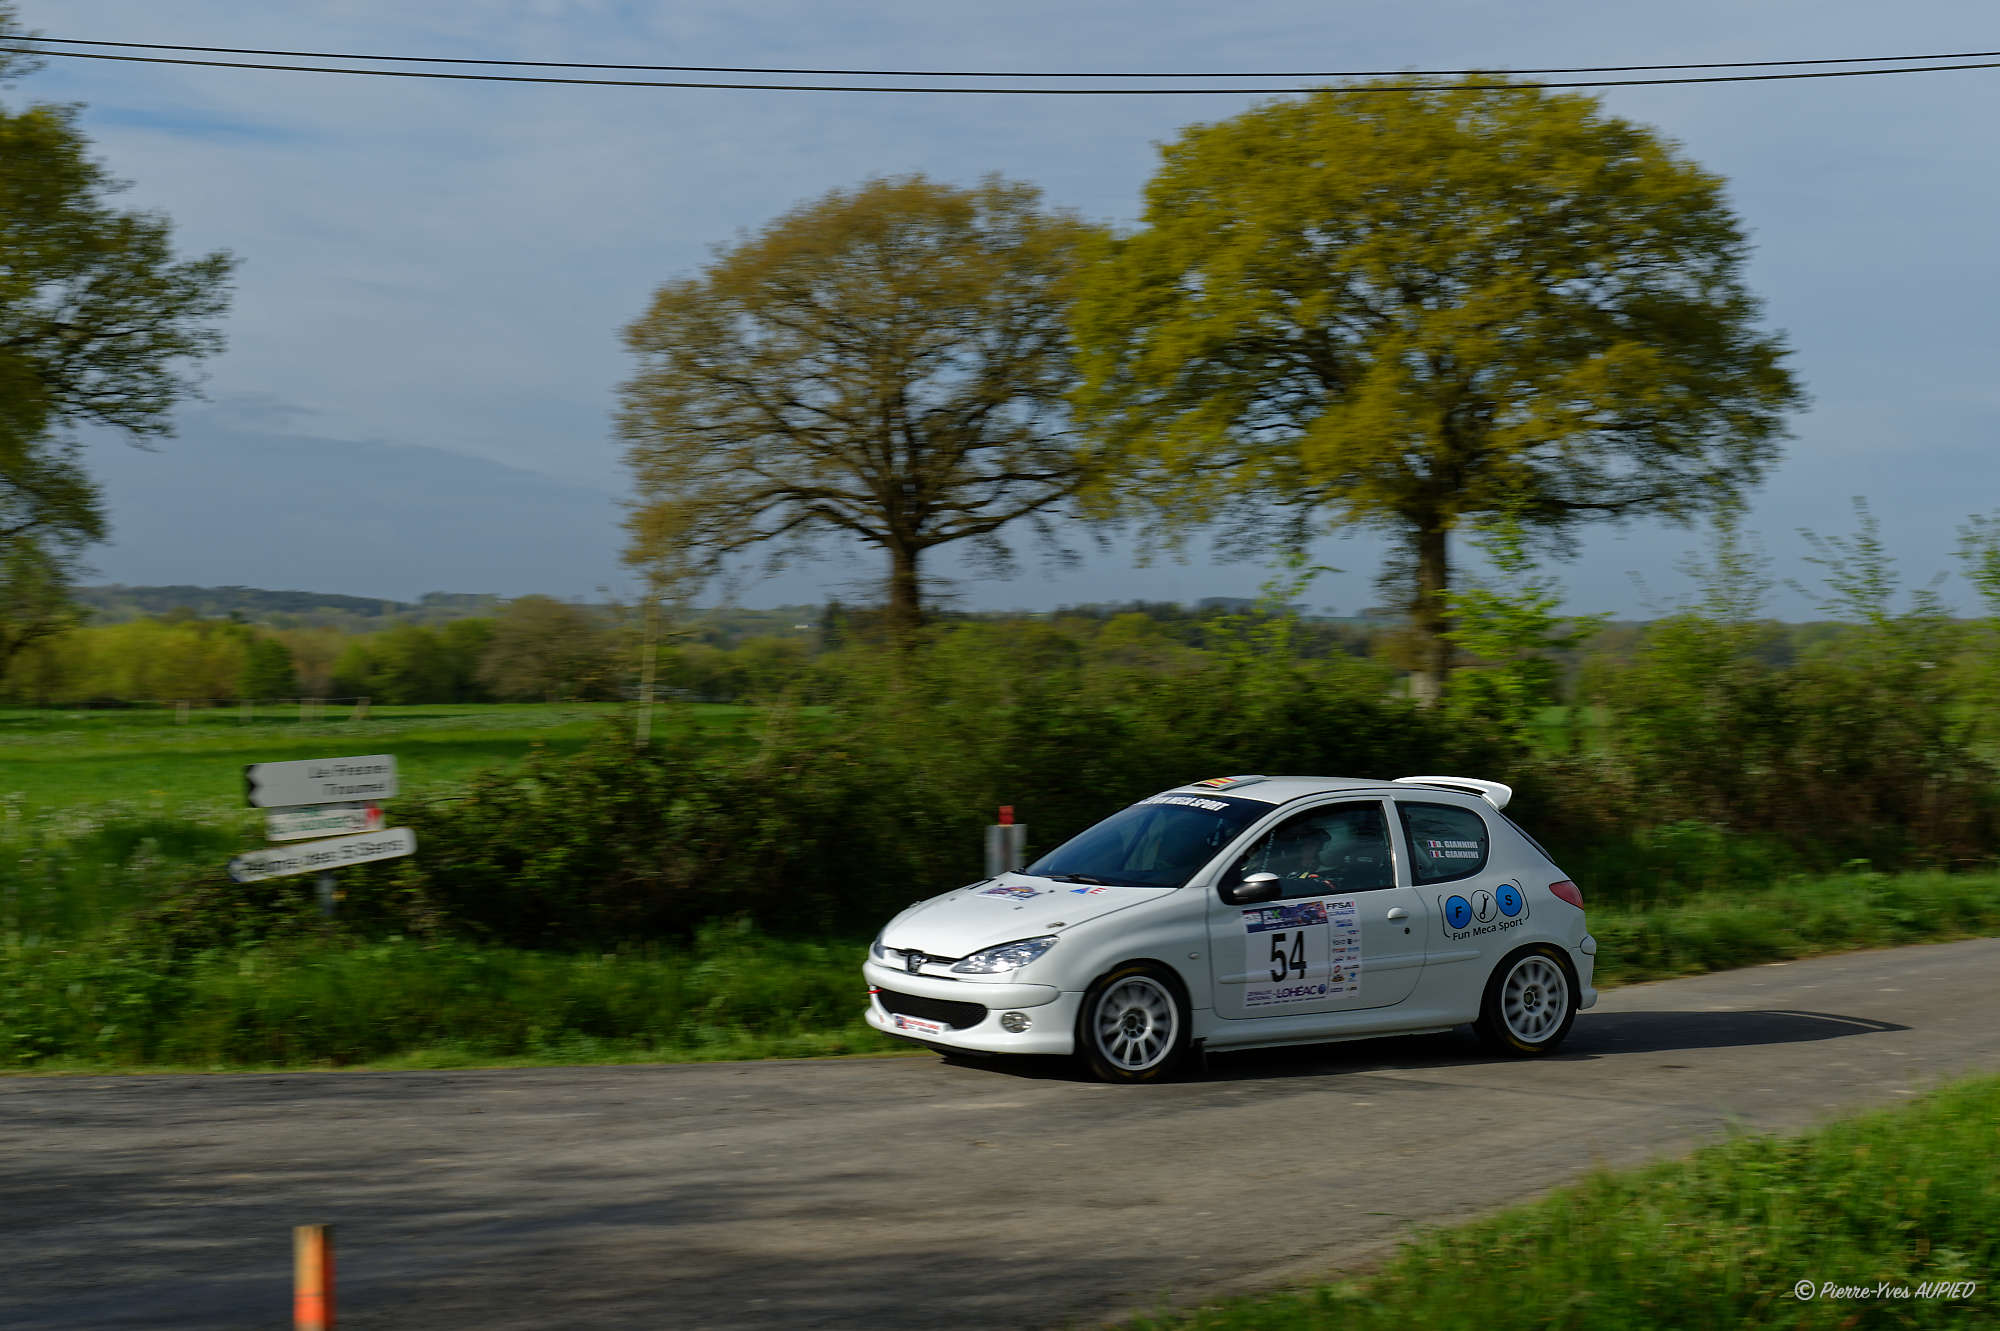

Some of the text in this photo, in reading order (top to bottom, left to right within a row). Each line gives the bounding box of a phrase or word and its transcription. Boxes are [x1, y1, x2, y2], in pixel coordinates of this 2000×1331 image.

[1444, 840, 1478, 849] GIANNINI
[1445, 850, 1479, 859] GIANNINI
[1326, 901, 1352, 910] FFSA
[1455, 894, 1513, 918] F S
[1453, 917, 1523, 941] Fun Meca Sport
[1270, 931, 1307, 983] 54
